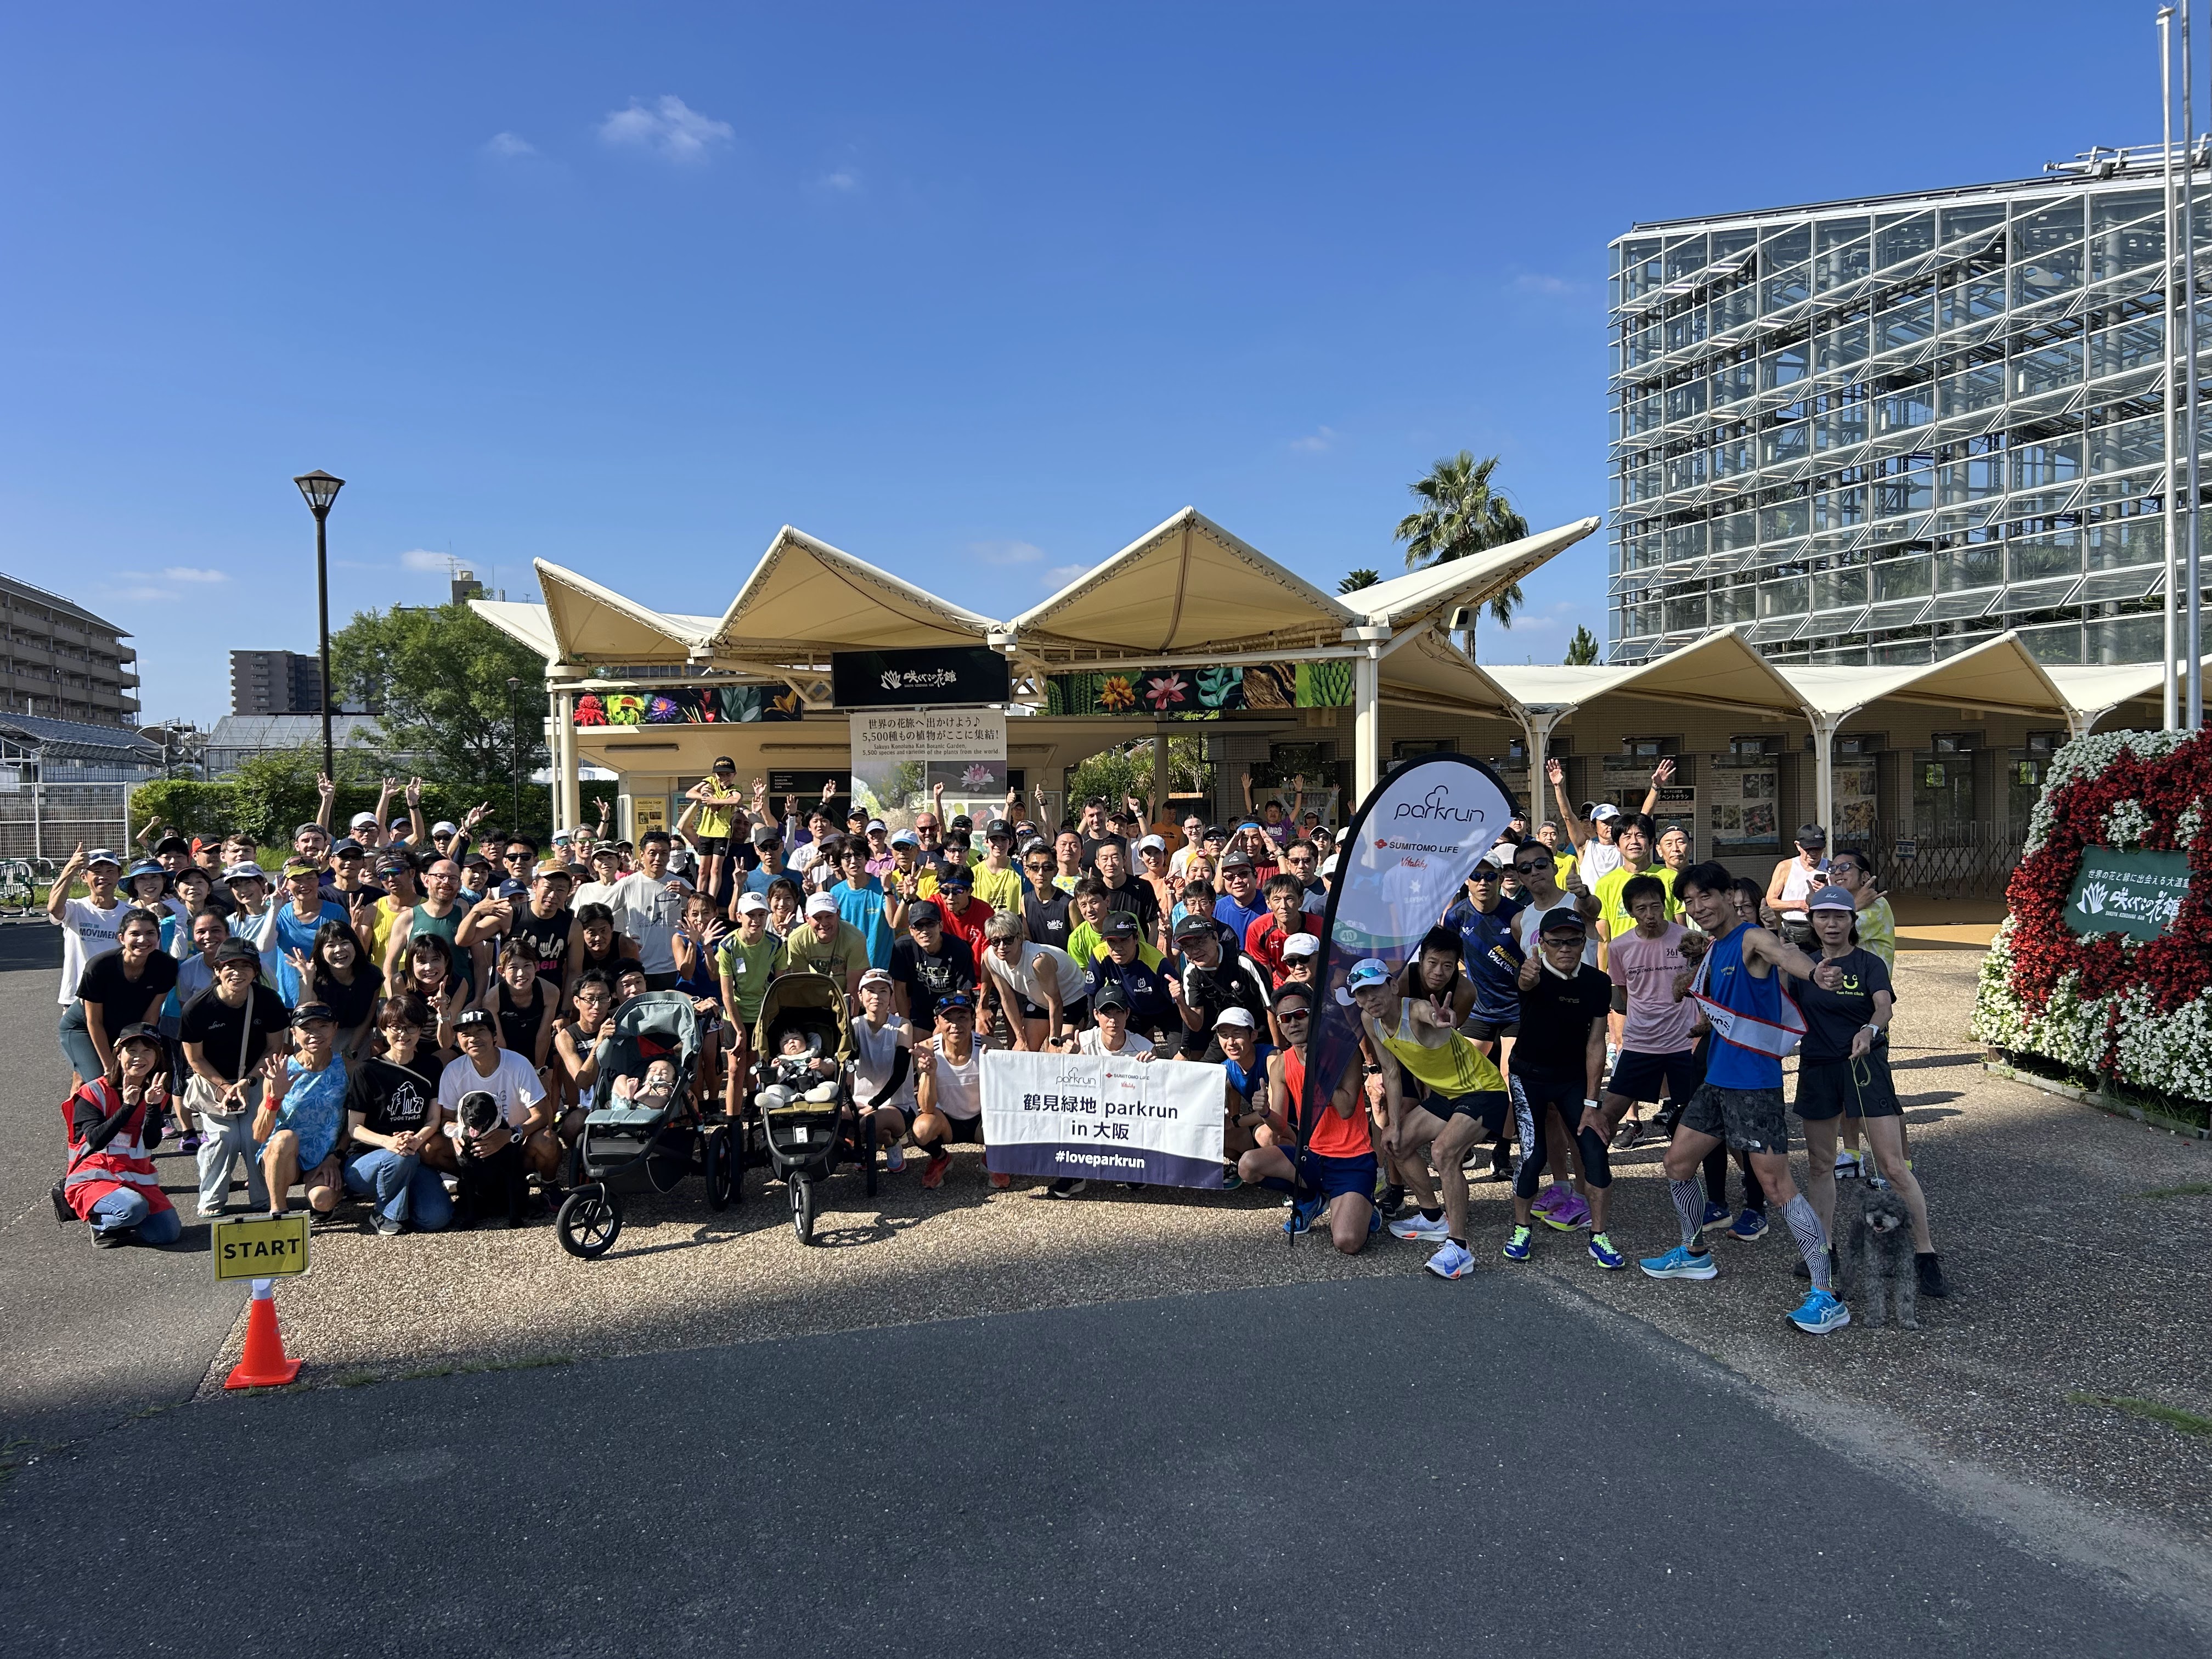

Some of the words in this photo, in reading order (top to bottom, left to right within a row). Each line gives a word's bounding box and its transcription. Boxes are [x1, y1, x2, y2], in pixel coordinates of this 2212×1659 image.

[1394, 785, 1484, 822] parkrun
[1389, 842, 1437, 853] SUMITOMO
[1439, 845, 1459, 854] LIFE
[1401, 855, 1428, 871] Vitality
[80, 928, 118, 940] MOVIMEN
[462, 1011, 484, 1023] MT
[1056, 1066, 1096, 1085] parkrun
[1024, 1093, 1097, 1114] 鶴見緑地
[1105, 1100, 1178, 1119] parkrun
[390, 1114, 421, 1122] TOGETHER
[1071, 1120, 1087, 1136] in
[1093, 1121, 1130, 1141] 大阪
[1055, 1150, 1146, 1169] #loveparkrun
[224, 1238, 300, 1259] START
